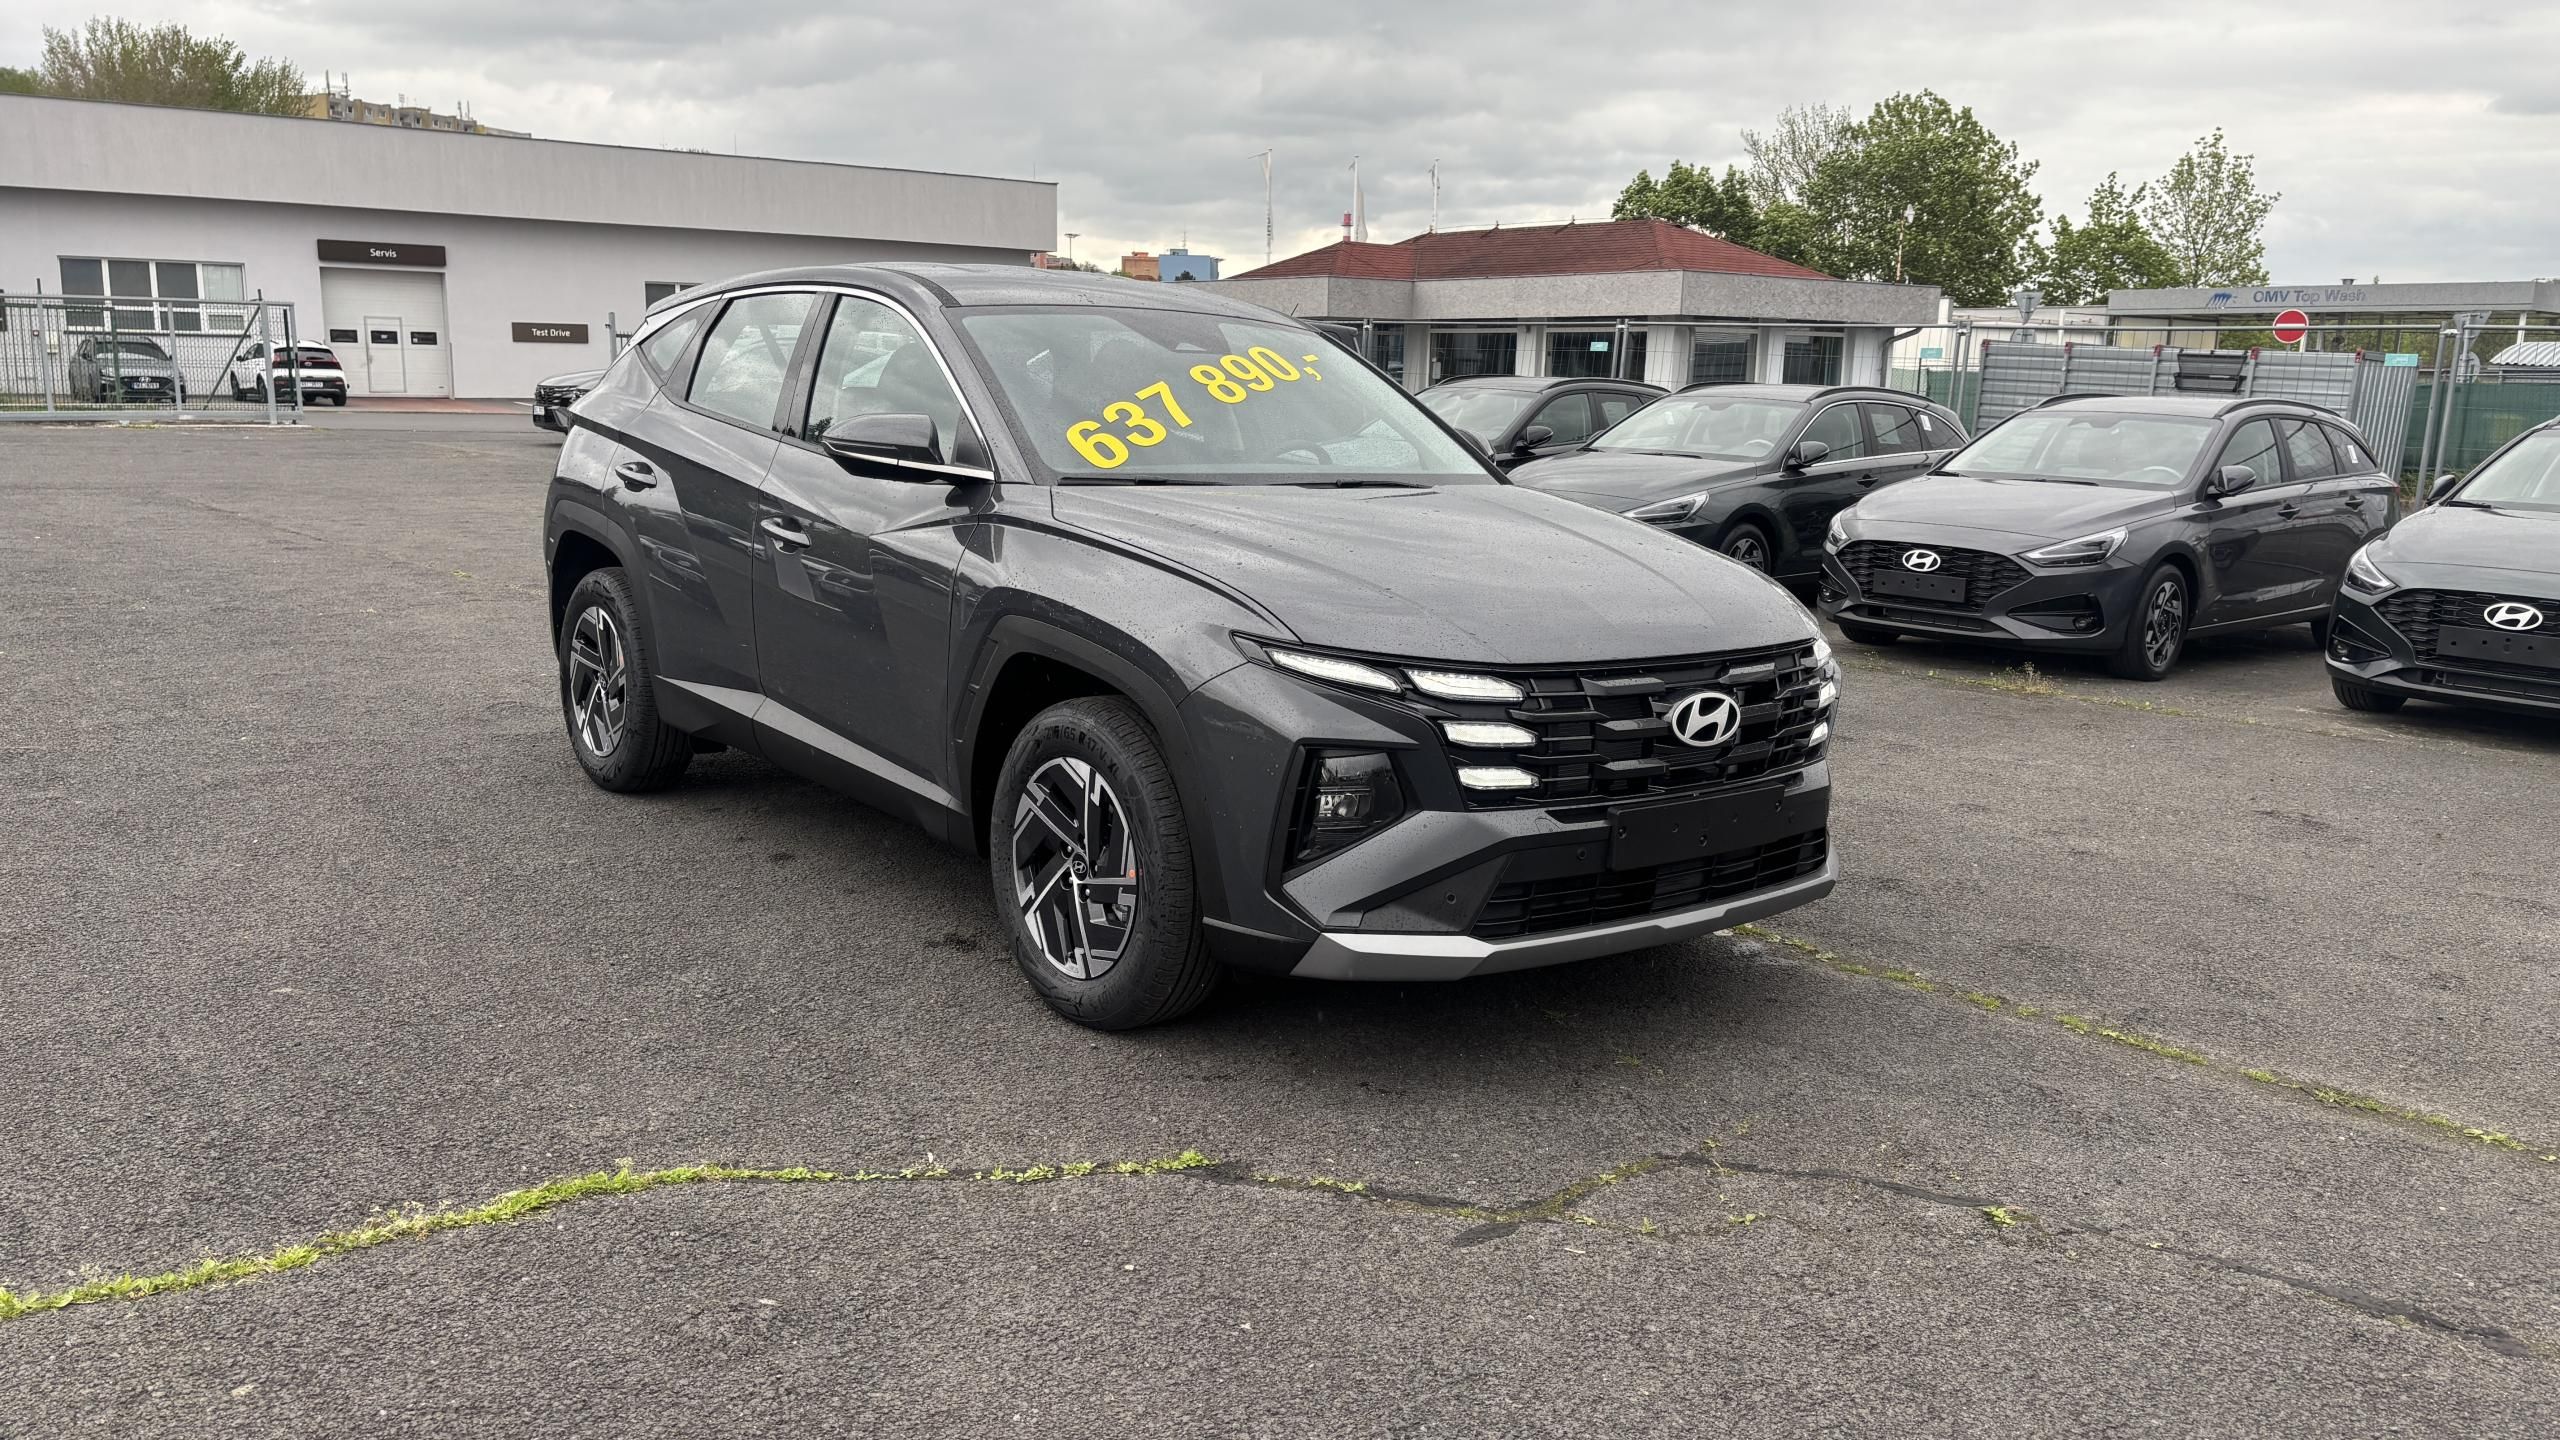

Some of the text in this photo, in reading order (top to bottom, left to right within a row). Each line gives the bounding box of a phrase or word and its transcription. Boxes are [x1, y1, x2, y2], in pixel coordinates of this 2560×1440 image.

[370, 248, 397, 258] Servis
[2253, 288, 2367, 304] OMV Top Wash
[532, 328, 571, 337] Test Drive
[1066, 380, 1193, 469] 637
